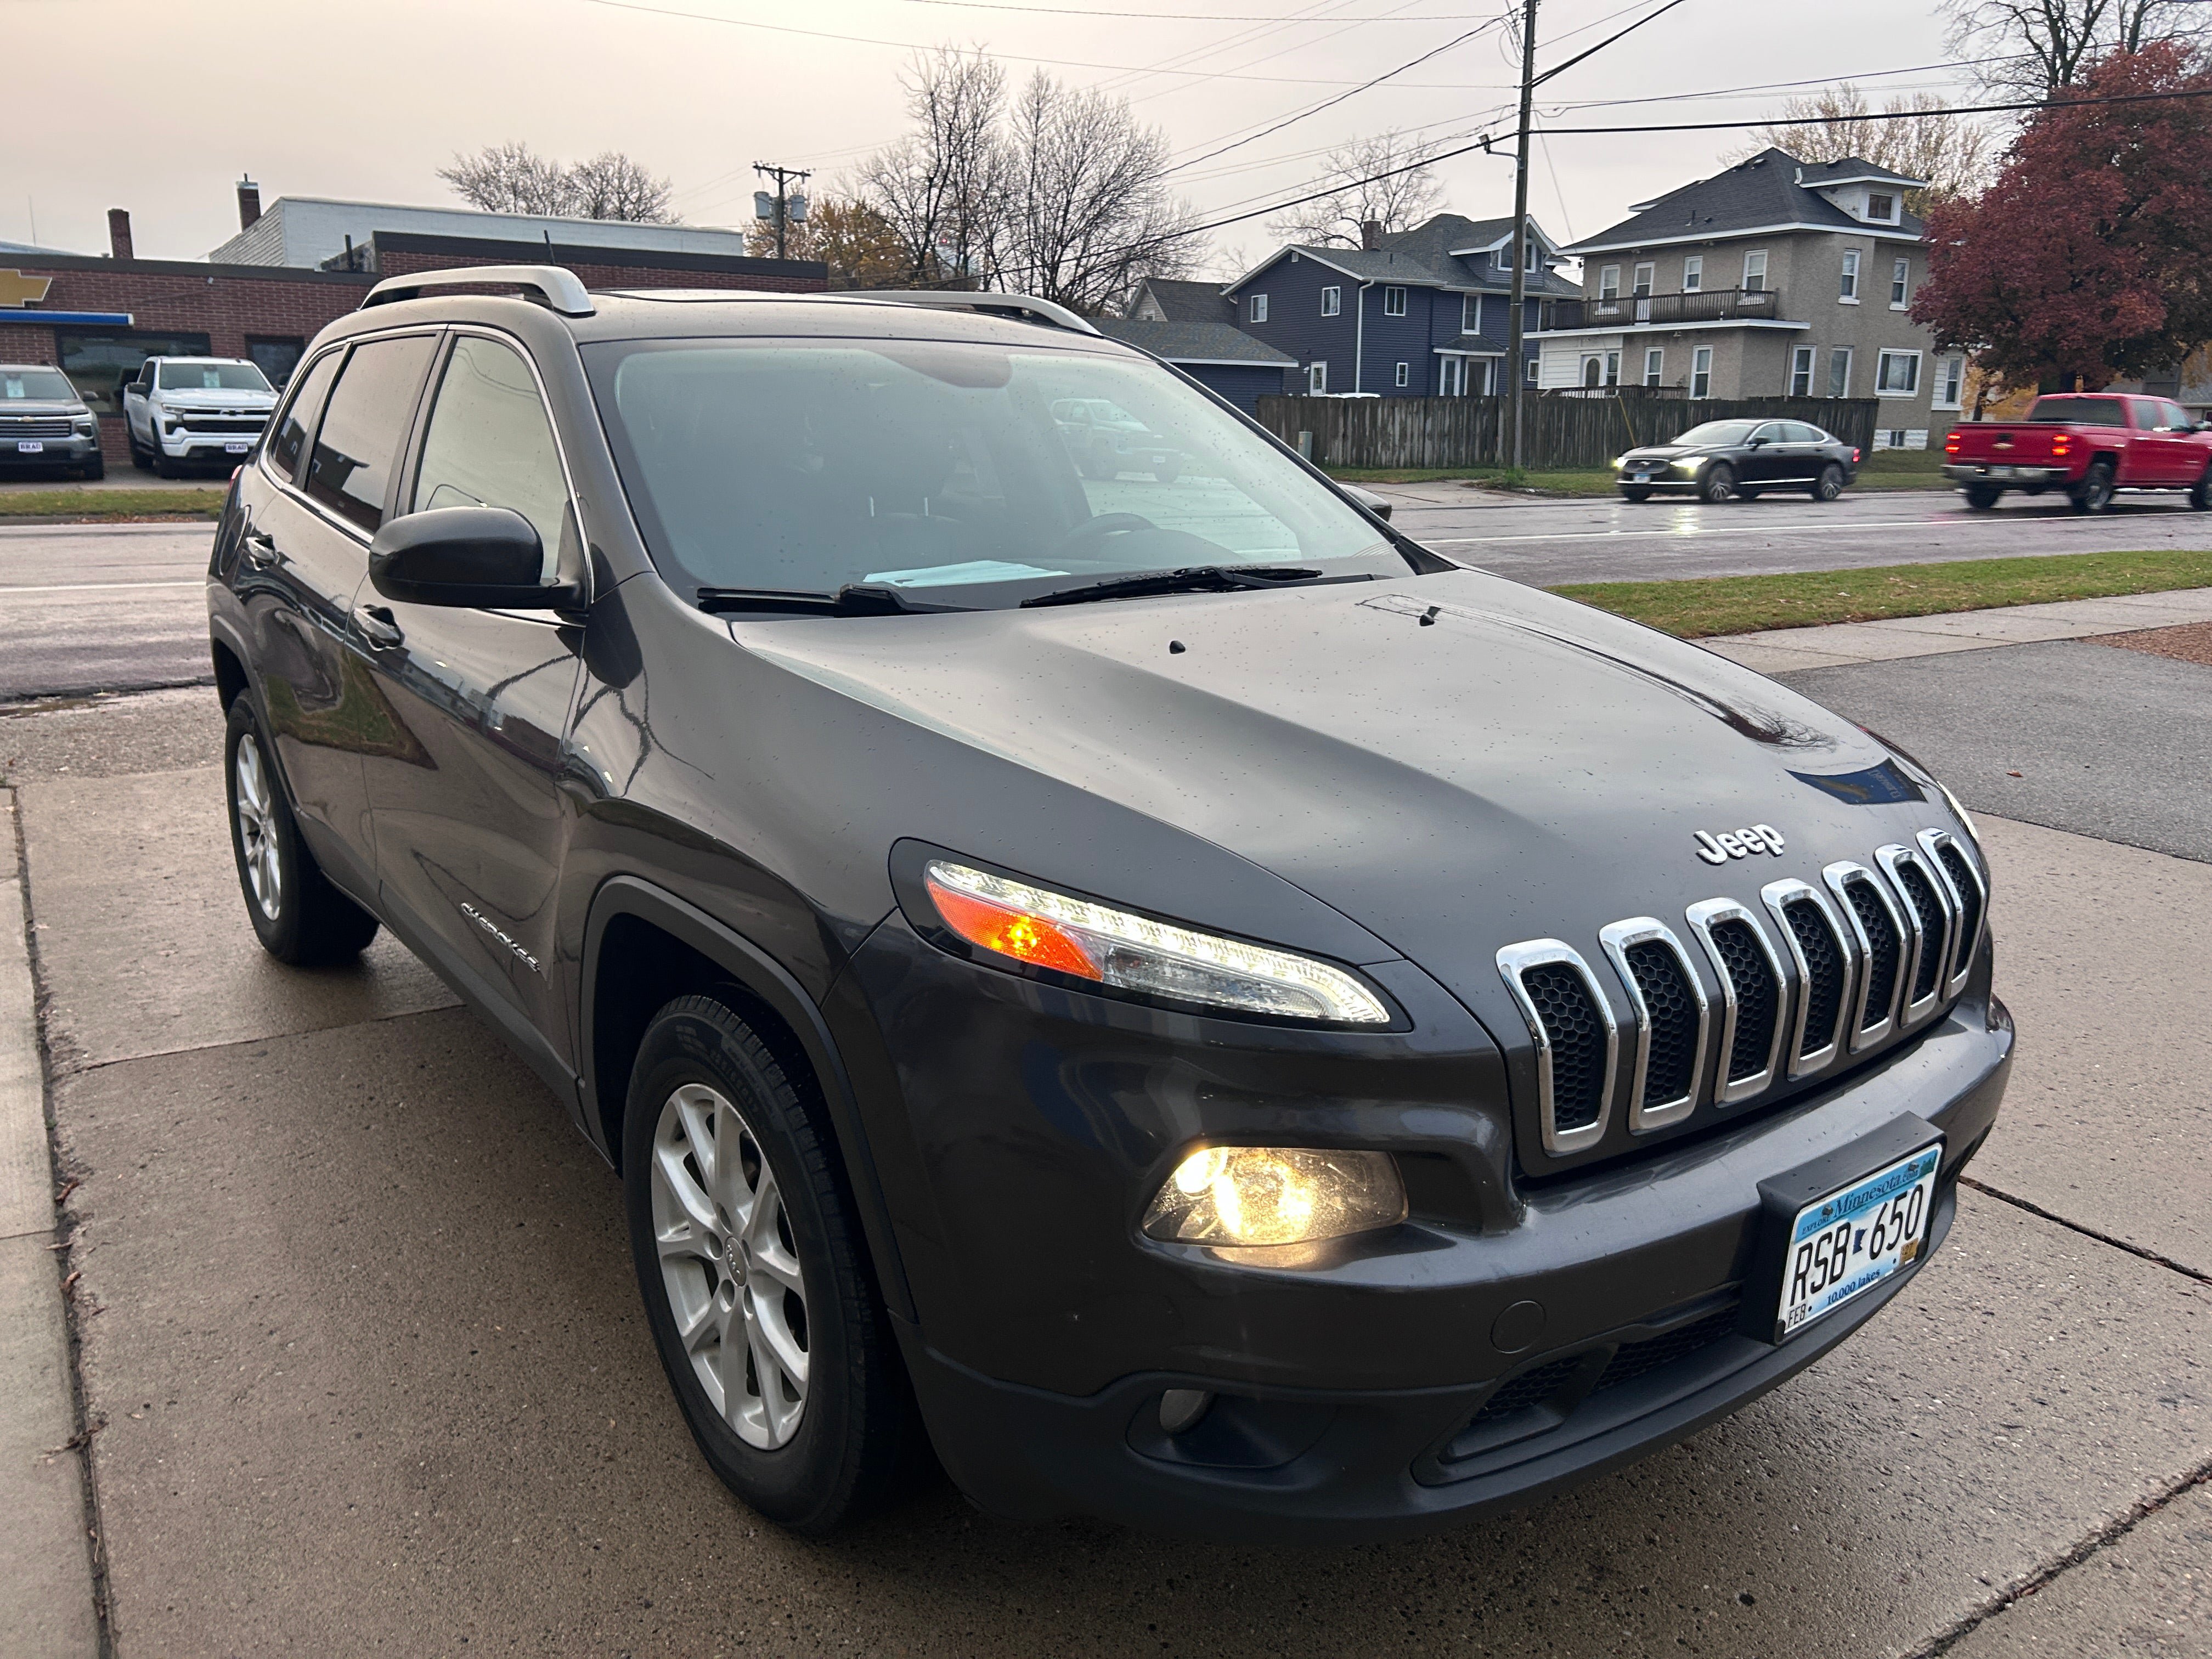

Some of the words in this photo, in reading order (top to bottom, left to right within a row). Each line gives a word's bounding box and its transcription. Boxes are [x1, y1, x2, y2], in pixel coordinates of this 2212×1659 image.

[1693, 824, 1784, 865] Jeep
[461, 902, 540, 972] CHEROKEE
[1802, 1216, 1831, 1235] EXPLORE
[1790, 1221, 1851, 1307] RSB
[1869, 1183, 1923, 1260] 650
[1857, 1269, 1881, 1289] lakes
[1788, 1304, 1806, 1328] FEB
